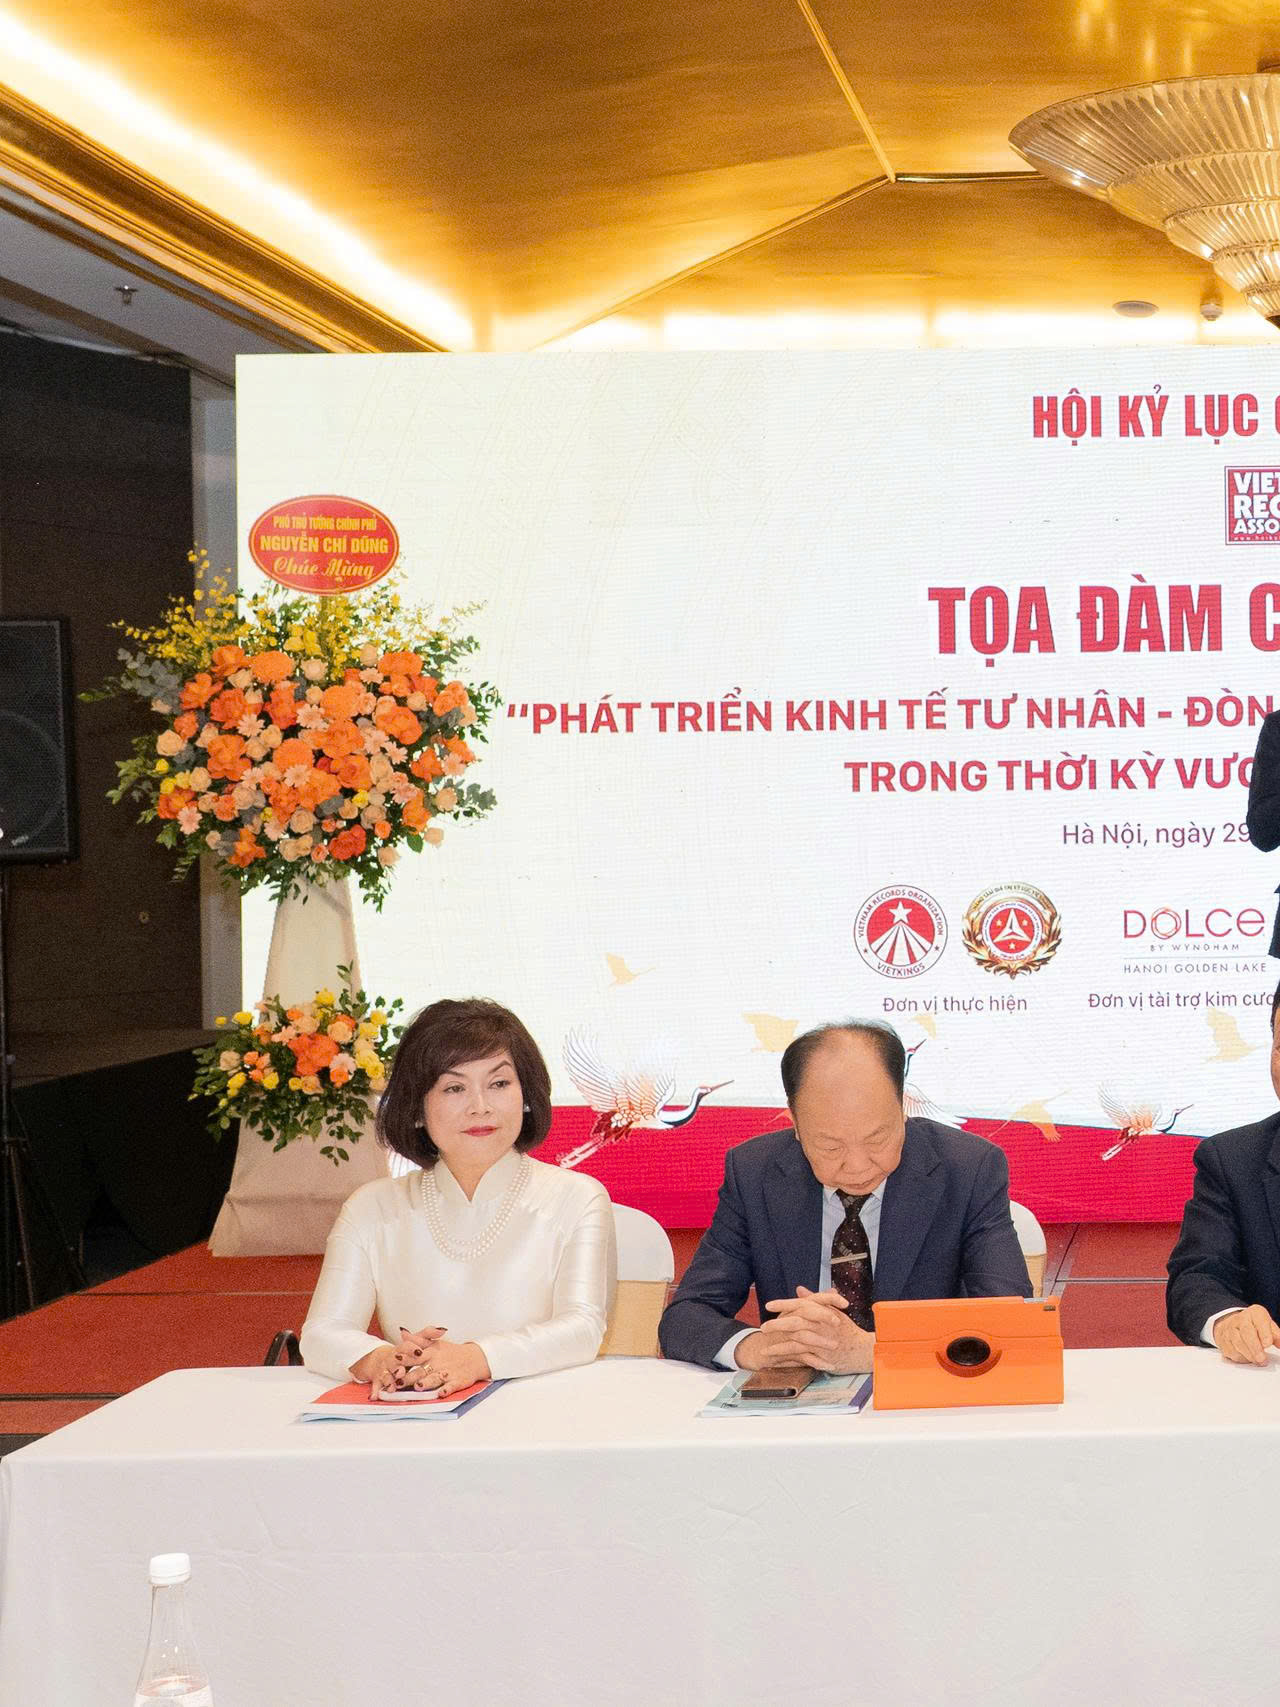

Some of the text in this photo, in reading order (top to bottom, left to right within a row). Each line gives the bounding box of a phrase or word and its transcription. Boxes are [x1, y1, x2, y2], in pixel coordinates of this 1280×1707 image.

[1033, 388, 1101, 446] HỘI
[1119, 384, 1169, 437] KỶ
[1185, 394, 1258, 444] LỤC
[260, 531, 389, 554] NGUYỄN CHÍ DŨNG
[273, 556, 376, 582] Chúc Mừng
[928, 586, 1056, 668] TỌA
[1077, 574, 1222, 652] ĐÀM
[651, 687, 772, 733] TRIỂN
[786, 700, 886, 731] KINH
[899, 688, 947, 730] TẾ
[957, 693, 1017, 730] TƯ
[1027, 689, 1144, 729] NHÂN
[1184, 688, 1274, 727] ĐÒN
[844, 760, 987, 793] TRONG
[998, 752, 1097, 791] THỜI
[1111, 751, 1165, 790] KỲ
[1064, 821, 1094, 845] Hà
[1103, 822, 1148, 849] Nội,
[1156, 821, 1215, 849] ngày
[858, 904, 874, 938] VIETNAM
[872, 888, 907, 906] RECORDS
[907, 890, 945, 936] ORGANIZATION
[1150, 943, 1240, 952] BY WYNDHAM
[1123, 962, 1267, 974] HANOI GOLDEN LAKE
[882, 995, 1028, 1015] Đơn vị thực hiện
[1088, 993, 1124, 1008] Đơn
[1129, 992, 1143, 1011] vị
[1149, 991, 1170, 1008] tài
[1175, 992, 1201, 1011] trợ
[1205, 991, 1237, 1007] kim
